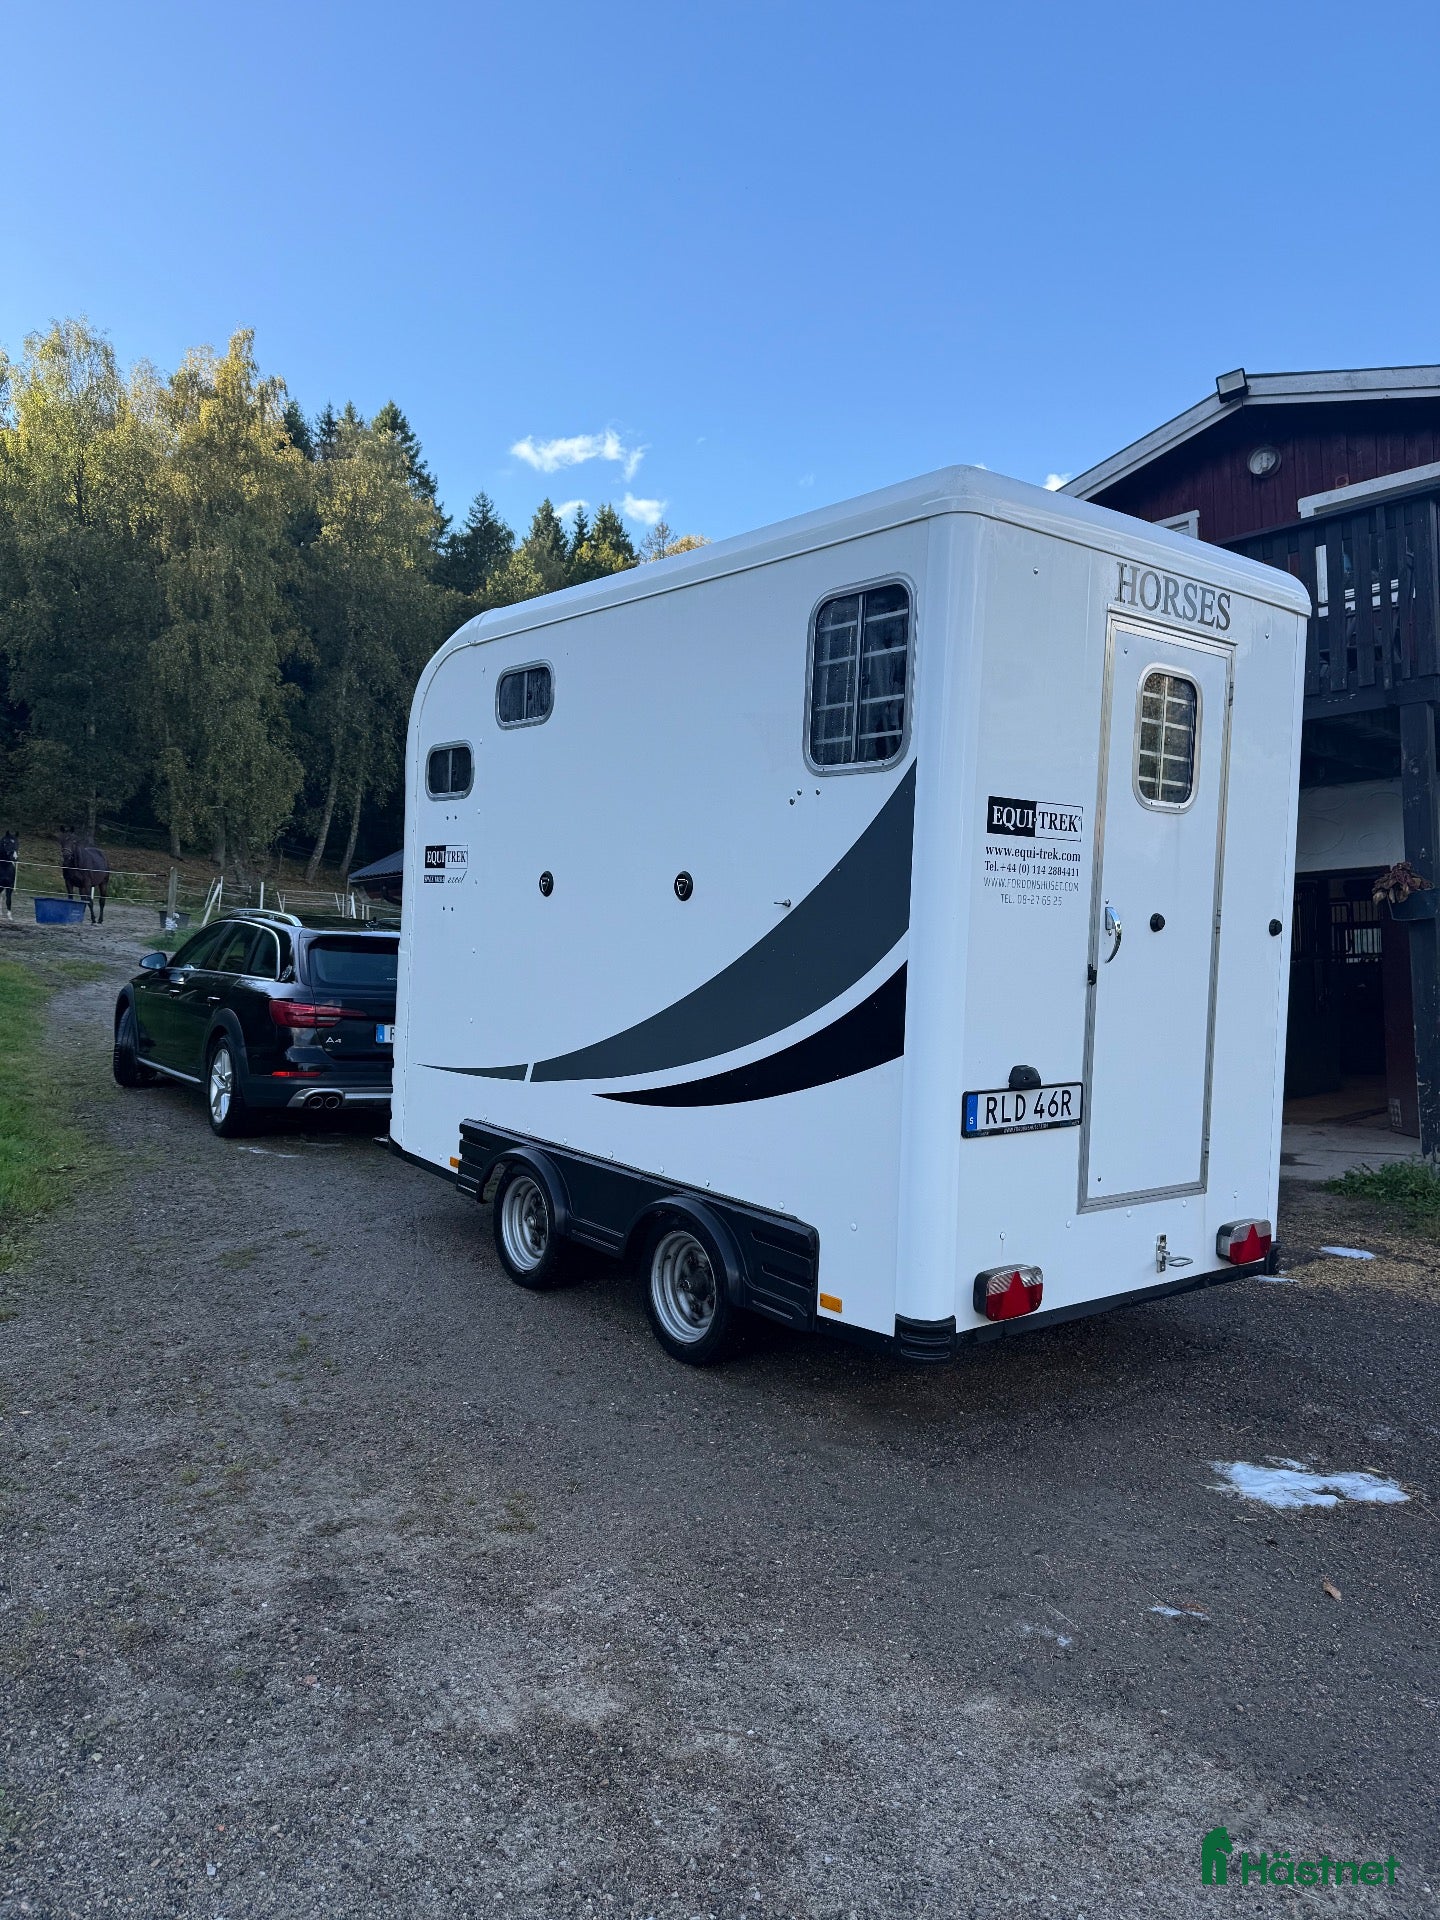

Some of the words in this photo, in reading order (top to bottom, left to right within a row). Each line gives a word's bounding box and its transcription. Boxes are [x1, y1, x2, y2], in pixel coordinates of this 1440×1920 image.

[1113, 561, 1232, 631] HORSES
[985, 846, 1081, 862] www.equi-trek.com
[1018, 863, 1030, 876] (0)
[1032, 865, 1046, 875] 114
[1000, 893, 1015, 904] TEL.
[325, 1036, 342, 1044] A4
[985, 1093, 1027, 1125] RLD
[1033, 1089, 1072, 1119] 46R
[968, 1116, 975, 1125] S
